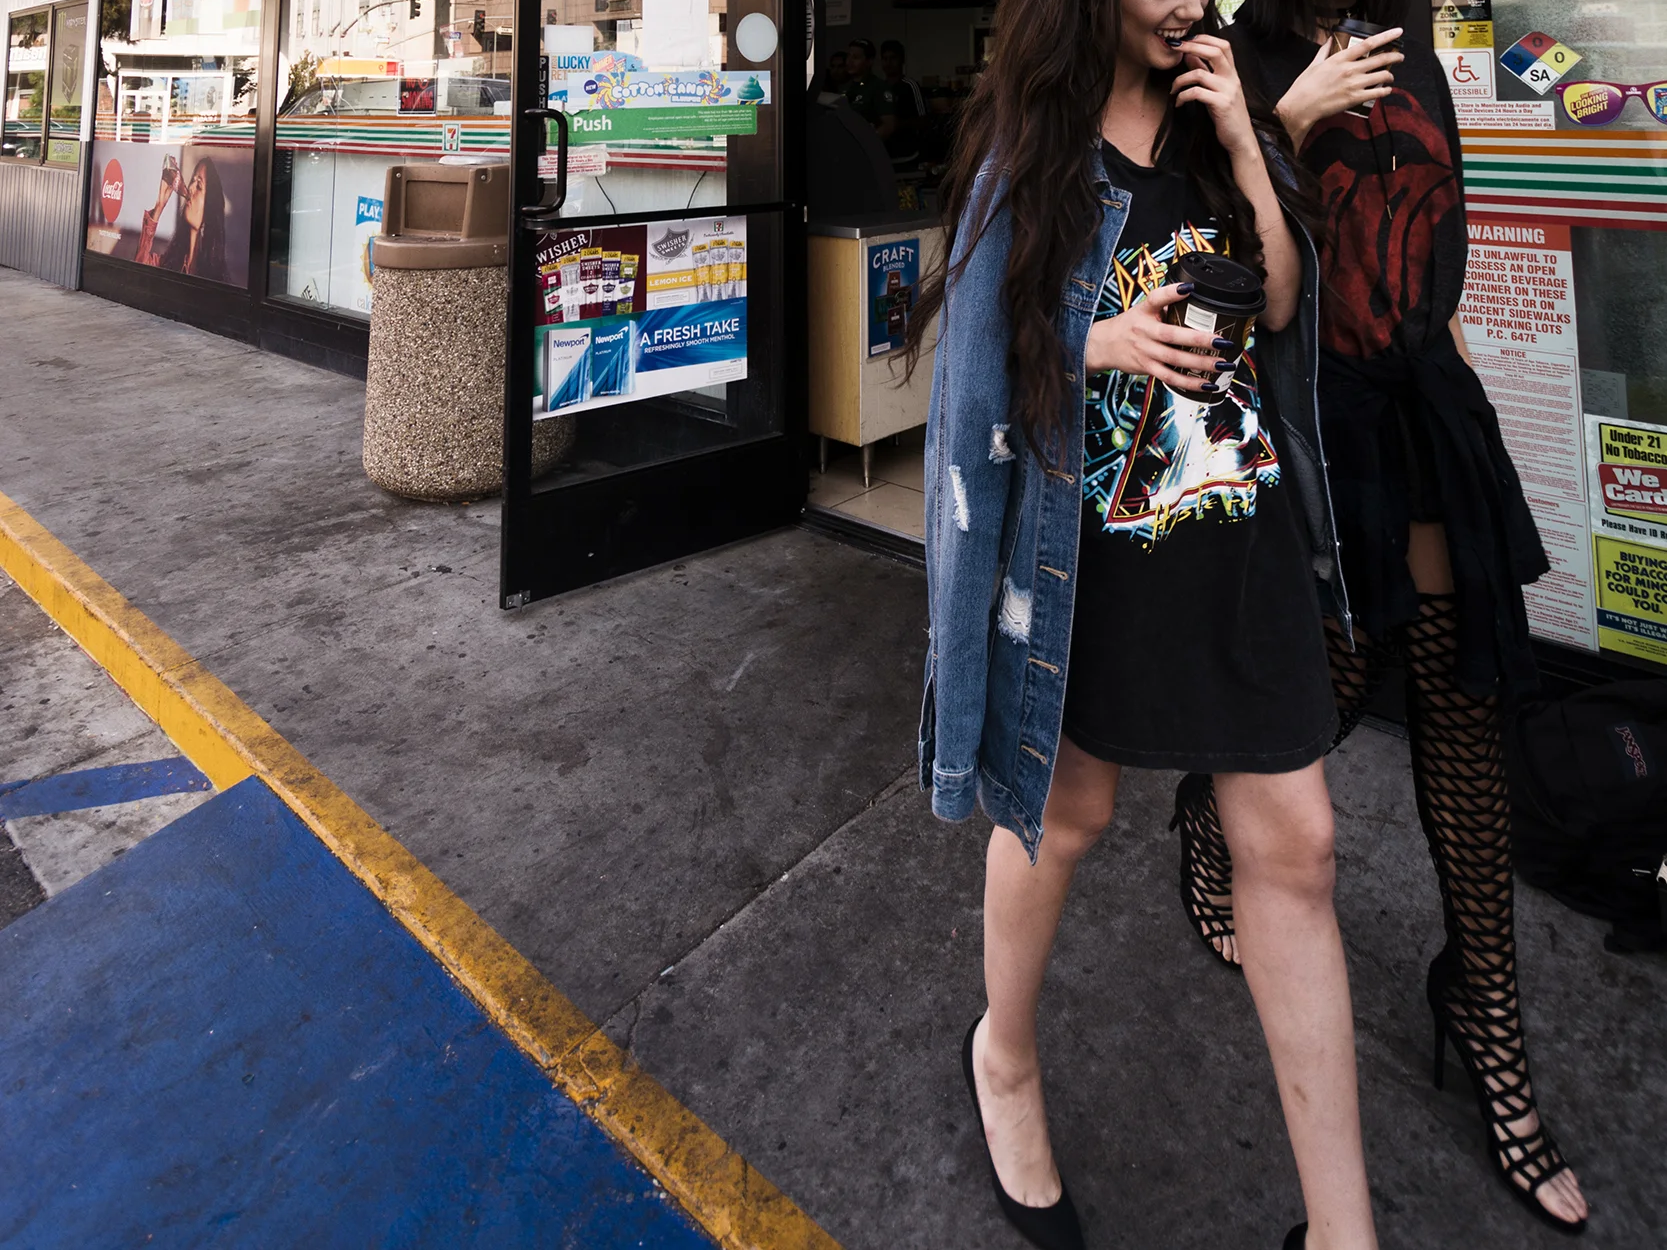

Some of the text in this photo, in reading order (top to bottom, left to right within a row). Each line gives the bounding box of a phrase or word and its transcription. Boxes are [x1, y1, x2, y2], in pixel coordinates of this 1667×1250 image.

[558, 56, 590, 70] LUCKY
[1530, 69, 1550, 82] SA
[612, 81, 712, 98] COTTON CANDY
[1570, 92, 1608, 112] LOOKING
[1576, 101, 1608, 118] BRIGHT
[573, 115, 612, 132] Push
[358, 202, 380, 218] PLAY
[657, 234, 687, 251] SWISHER
[1467, 224, 1545, 244] WARNING
[536, 233, 588, 264] WISHER
[1471, 249, 1557, 264] IS UNLAWFUL TO
[873, 246, 914, 269] CRAFT
[883, 262, 905, 272] BLENDED
[1468, 260, 1556, 276] OSSESS AN OPEN
[649, 276, 677, 286] LEMON
[1465, 271, 1568, 288] COHOLIC BEVERAGE
[1463, 282, 1566, 300] ONTAINER ON THESE
[1466, 293, 1555, 310] PREMISES OR ON
[1463, 315, 1562, 335] AND PARKING LOTS
[1509, 309, 1571, 324] SIDEWALKS
[595, 332, 624, 344] Newport
[640, 318, 740, 346] A FRESH TAKE
[1487, 329, 1537, 343] P.C. 647E
[553, 338, 585, 348] Newport
[644, 334, 735, 354] REFRESHINGLY SMOOTH MENTHOL
[1500, 349, 1526, 358] NOTICE
[1610, 429, 1661, 449] Under 21
[1605, 443, 1620, 456] No
[1612, 468, 1660, 488] We
[1527, 496, 1559, 507] Customers
[1602, 519, 1626, 531] Please
[1629, 524, 1647, 535] Have
[1650, 529, 1658, 537] ID
[1620, 551, 1667, 571] BUYING
[1606, 570, 1667, 592] FOR MINO
[1608, 582, 1649, 599] COULD
[1632, 598, 1663, 614] YOU.
[1606, 614, 1620, 622] IT'S
[1621, 618, 1637, 627] NOT
[1640, 621, 1657, 630] JUST
[1624, 623, 1638, 632] IT'S
[1641, 627, 1667, 639] ILLEGA
